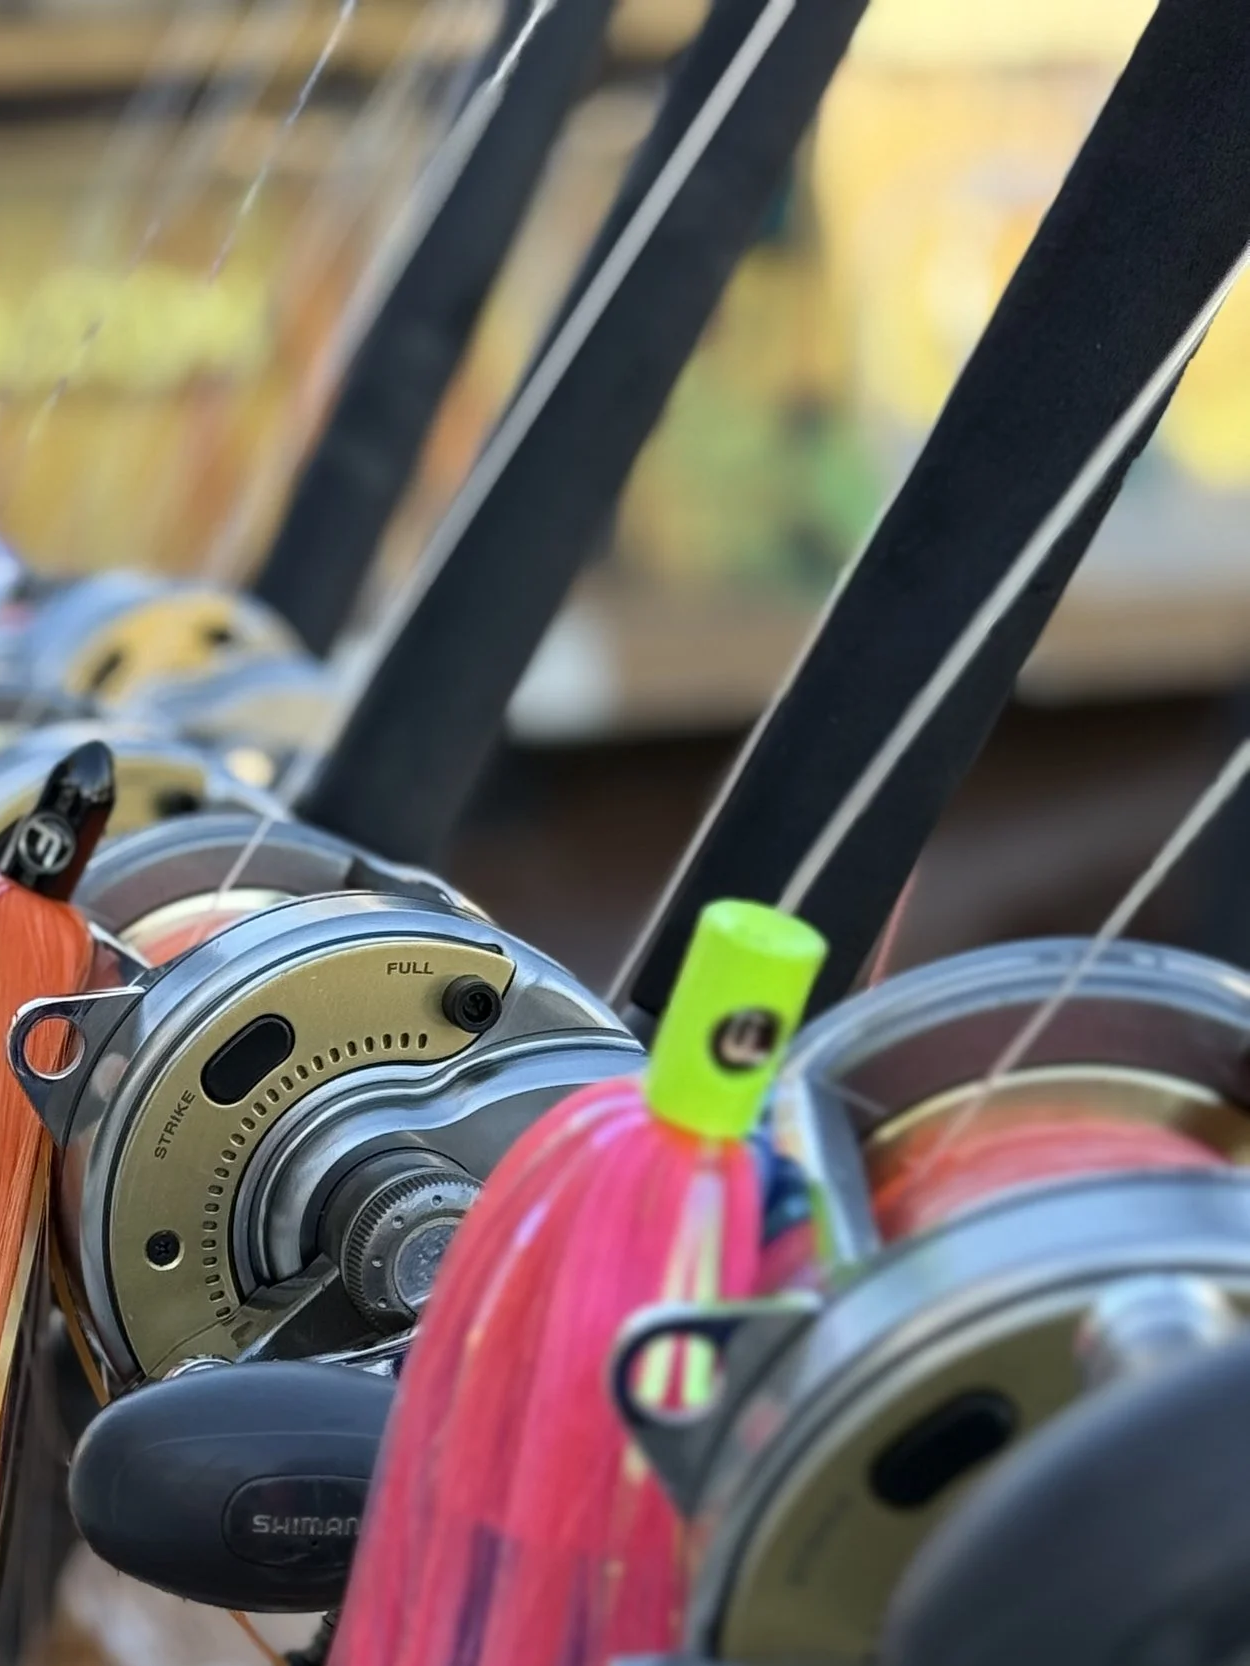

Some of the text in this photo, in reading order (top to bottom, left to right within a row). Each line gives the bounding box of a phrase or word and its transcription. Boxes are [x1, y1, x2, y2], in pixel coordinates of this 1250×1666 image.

[386, 961, 434, 975] FULL
[154, 1089, 196, 1160] STRIKE
[251, 1514, 361, 1536] SHIMAN
